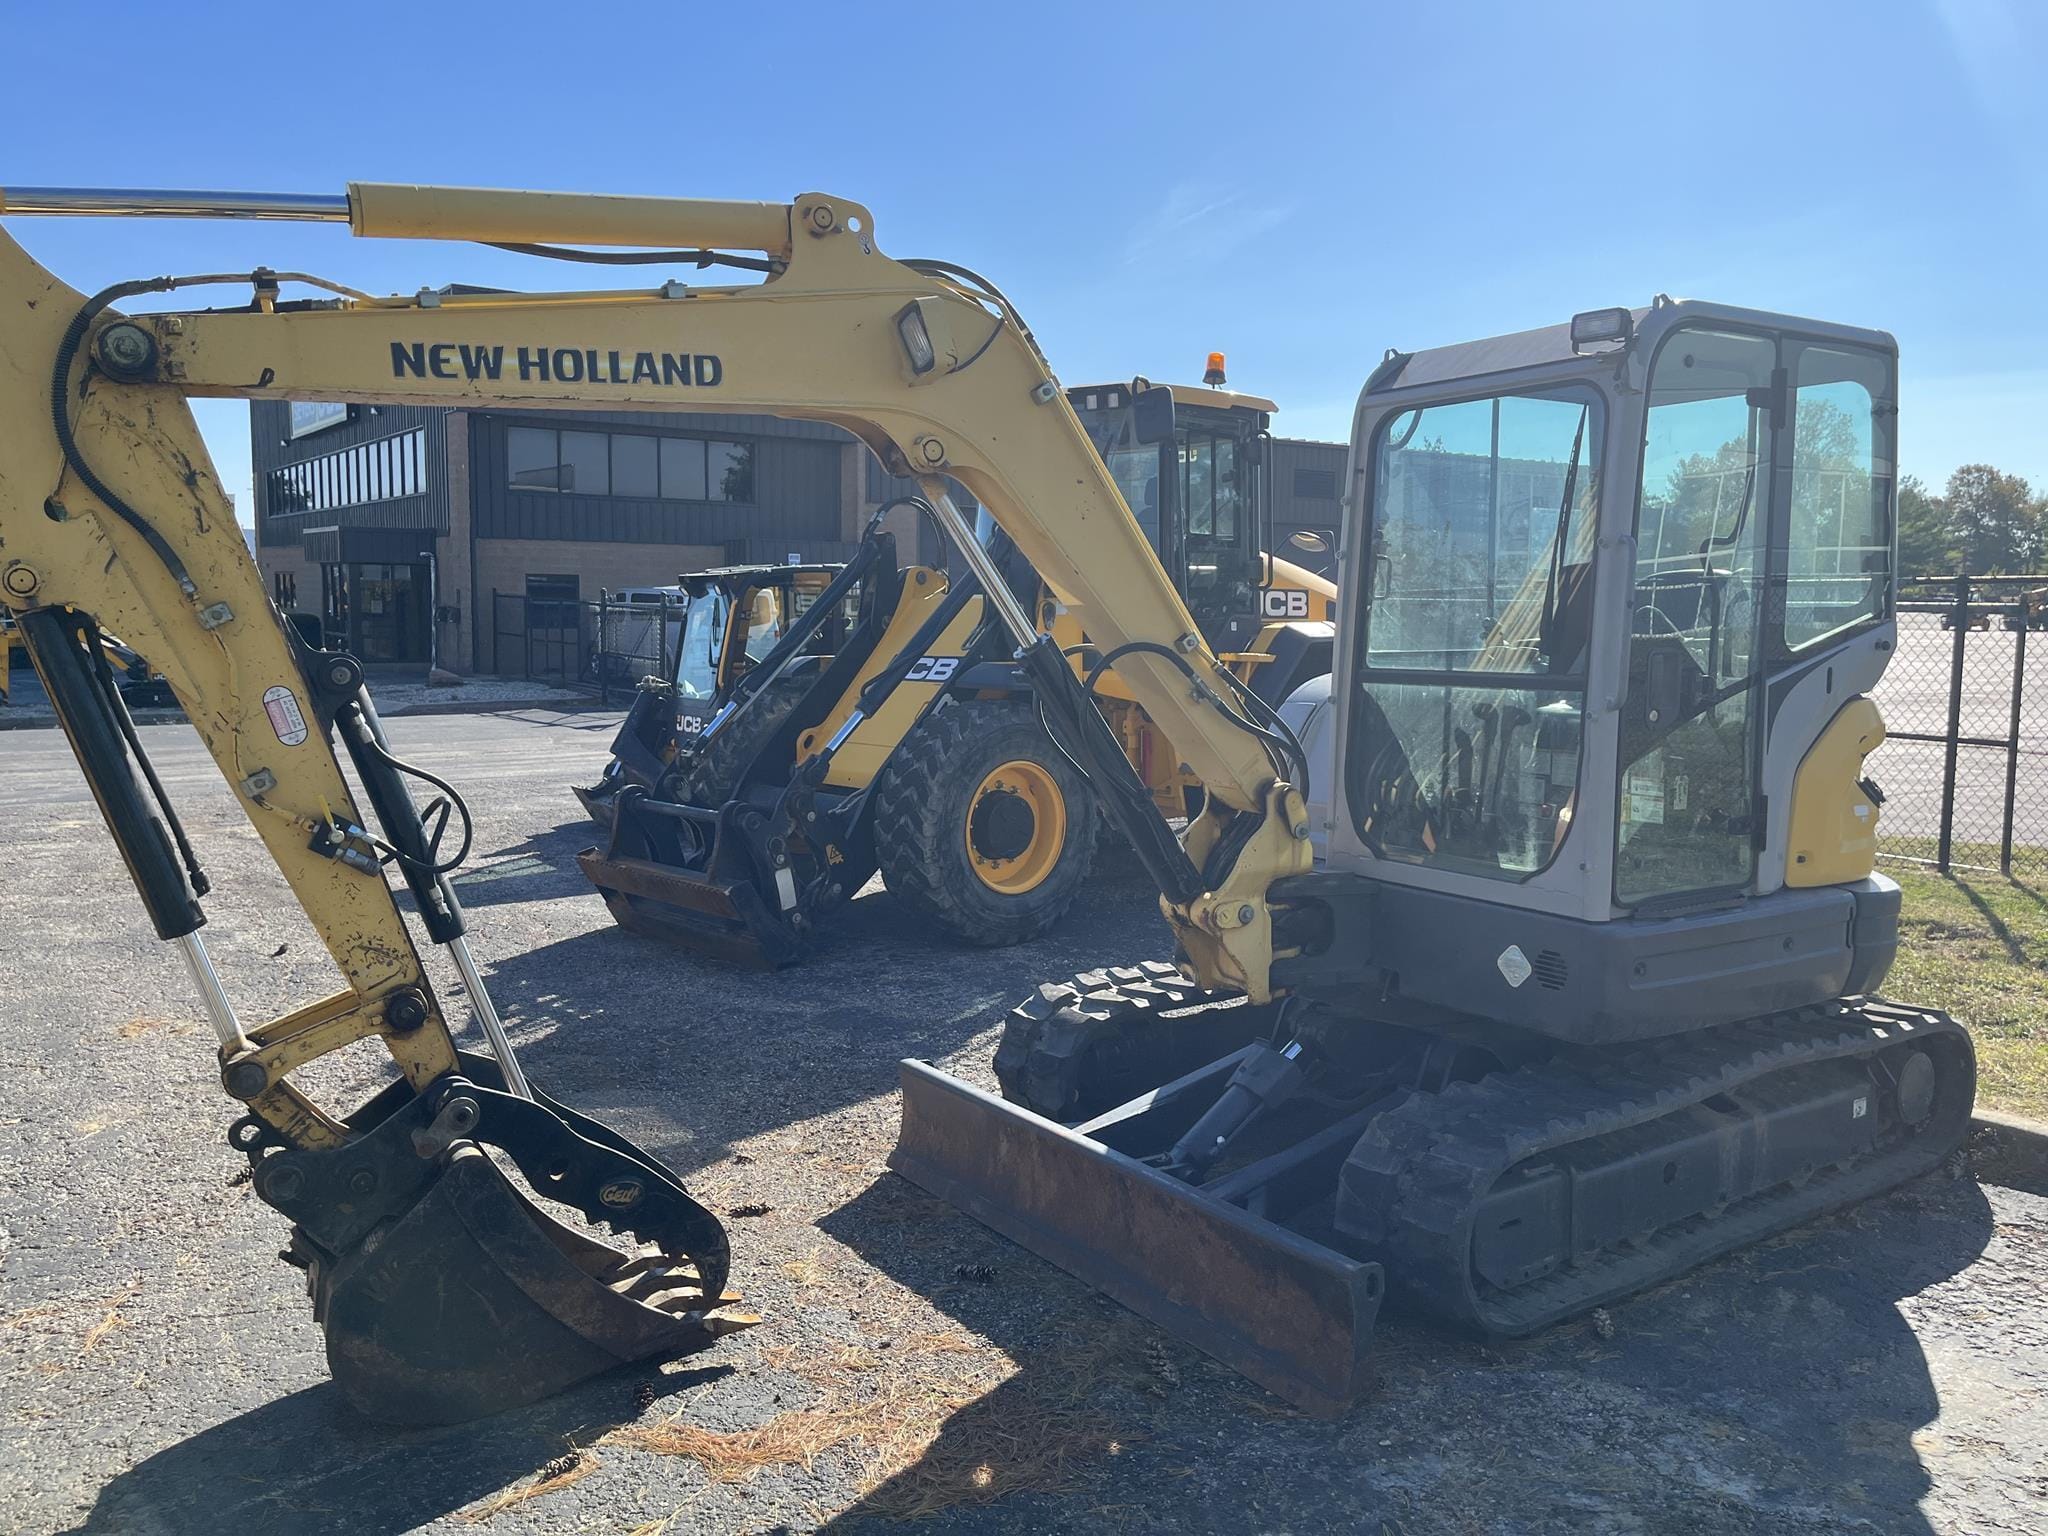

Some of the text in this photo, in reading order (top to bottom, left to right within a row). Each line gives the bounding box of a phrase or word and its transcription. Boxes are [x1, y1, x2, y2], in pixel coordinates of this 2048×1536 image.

[390, 342, 723, 387] NEW HOLLAND
[1260, 590, 1308, 617] CB
[904, 657, 959, 681] CB
[676, 715, 702, 733] JCB
